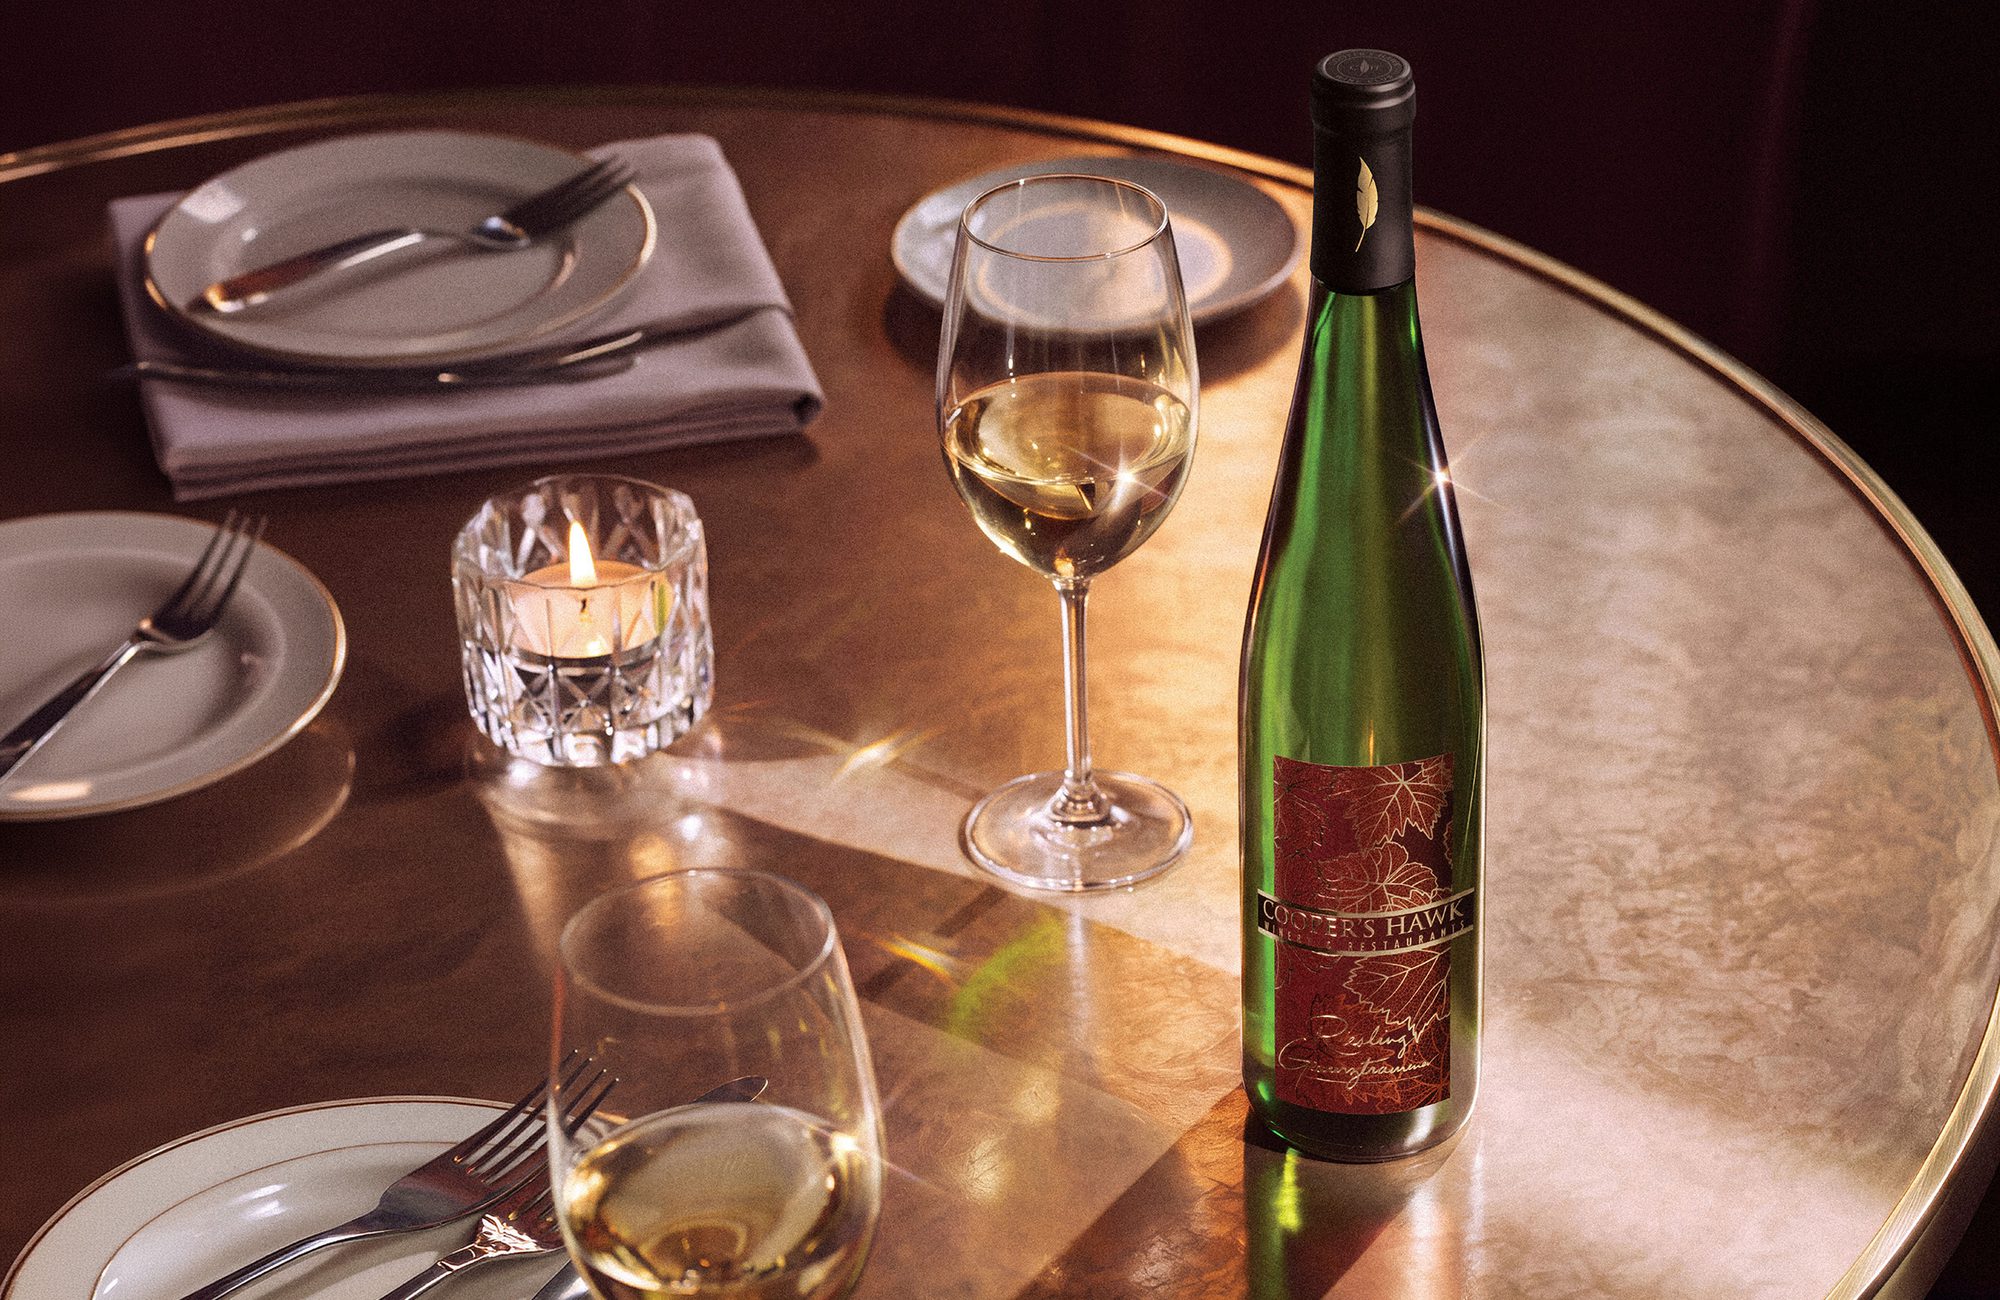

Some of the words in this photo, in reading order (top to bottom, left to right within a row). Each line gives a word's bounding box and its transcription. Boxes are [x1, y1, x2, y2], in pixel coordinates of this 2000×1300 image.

[1263, 899, 1375, 938] COOPER'S
[1386, 899, 1464, 937] HAWK
[1264, 921, 1311, 944] WINER
[1348, 921, 1464, 951] RESTAURANTS
